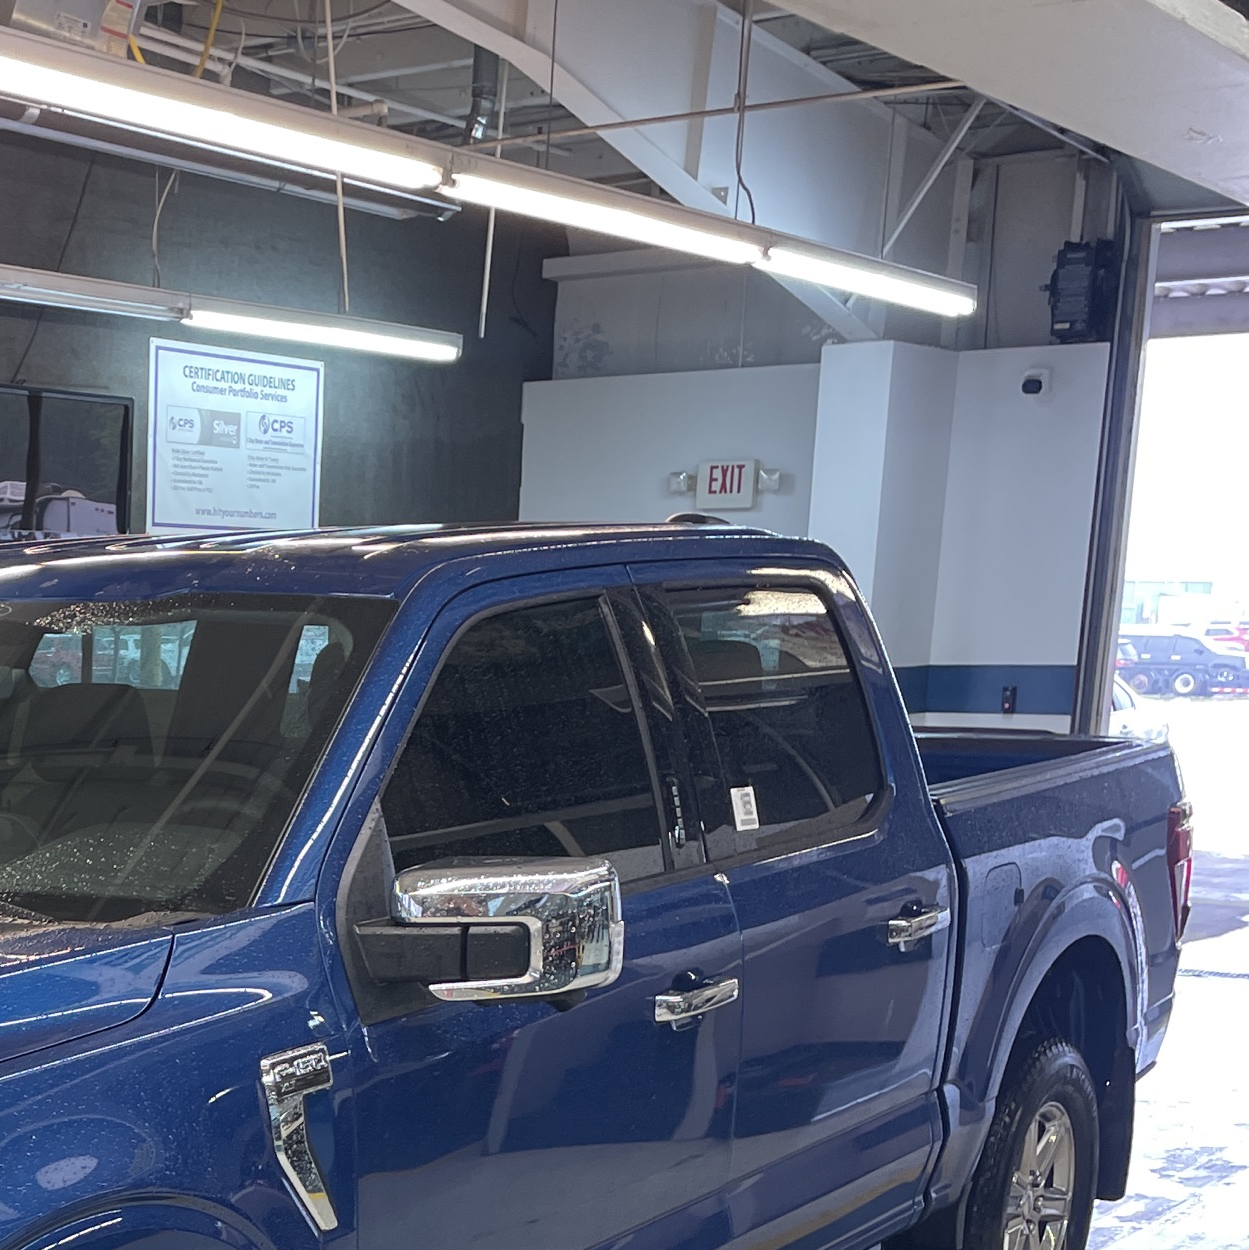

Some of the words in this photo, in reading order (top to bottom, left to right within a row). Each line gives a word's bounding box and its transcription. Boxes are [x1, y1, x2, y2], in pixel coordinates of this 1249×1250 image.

[182, 365, 246, 385] CERTIFICATION
[247, 373, 296, 391] GUIDELINES
[191, 381, 227, 396] Consumer
[228, 386, 259, 399] Portfolio
[260, 390, 288, 403] Services
[177, 418, 194, 429] CPS
[212, 420, 238, 435] Silver
[271, 419, 294, 434] CPS
[708, 464, 746, 494] EXIT
